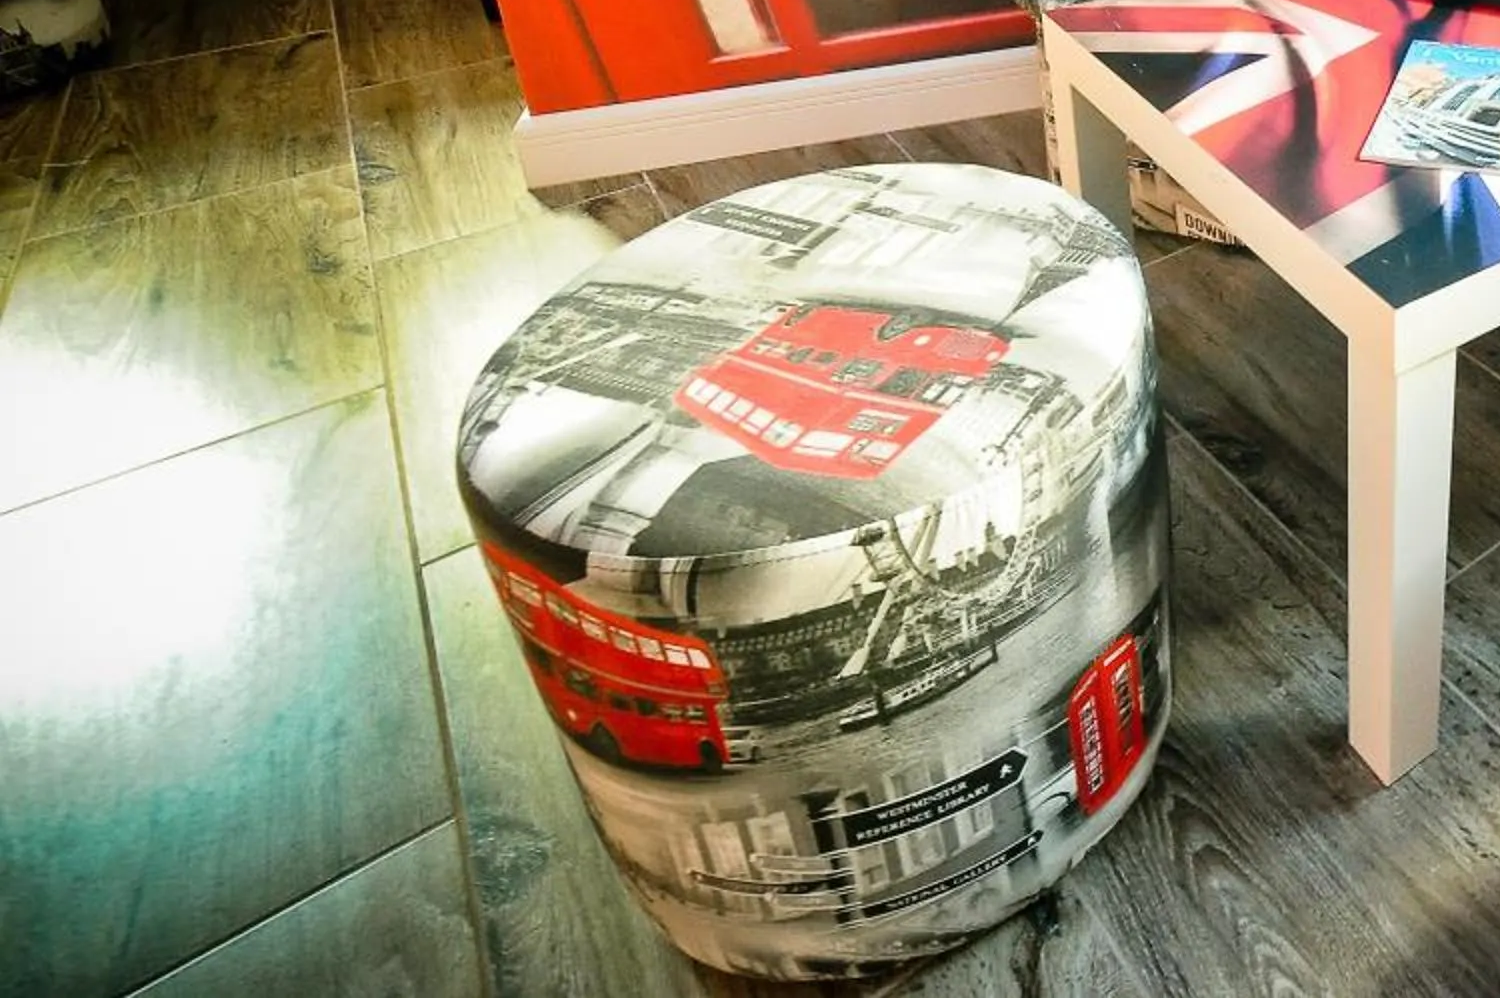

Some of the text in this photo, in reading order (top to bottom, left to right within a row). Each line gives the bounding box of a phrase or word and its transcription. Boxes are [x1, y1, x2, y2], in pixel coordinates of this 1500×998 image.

[854, 782, 991, 842] REFERENCE LIBRARY
[876, 781, 969, 821] WESTMINSTER
